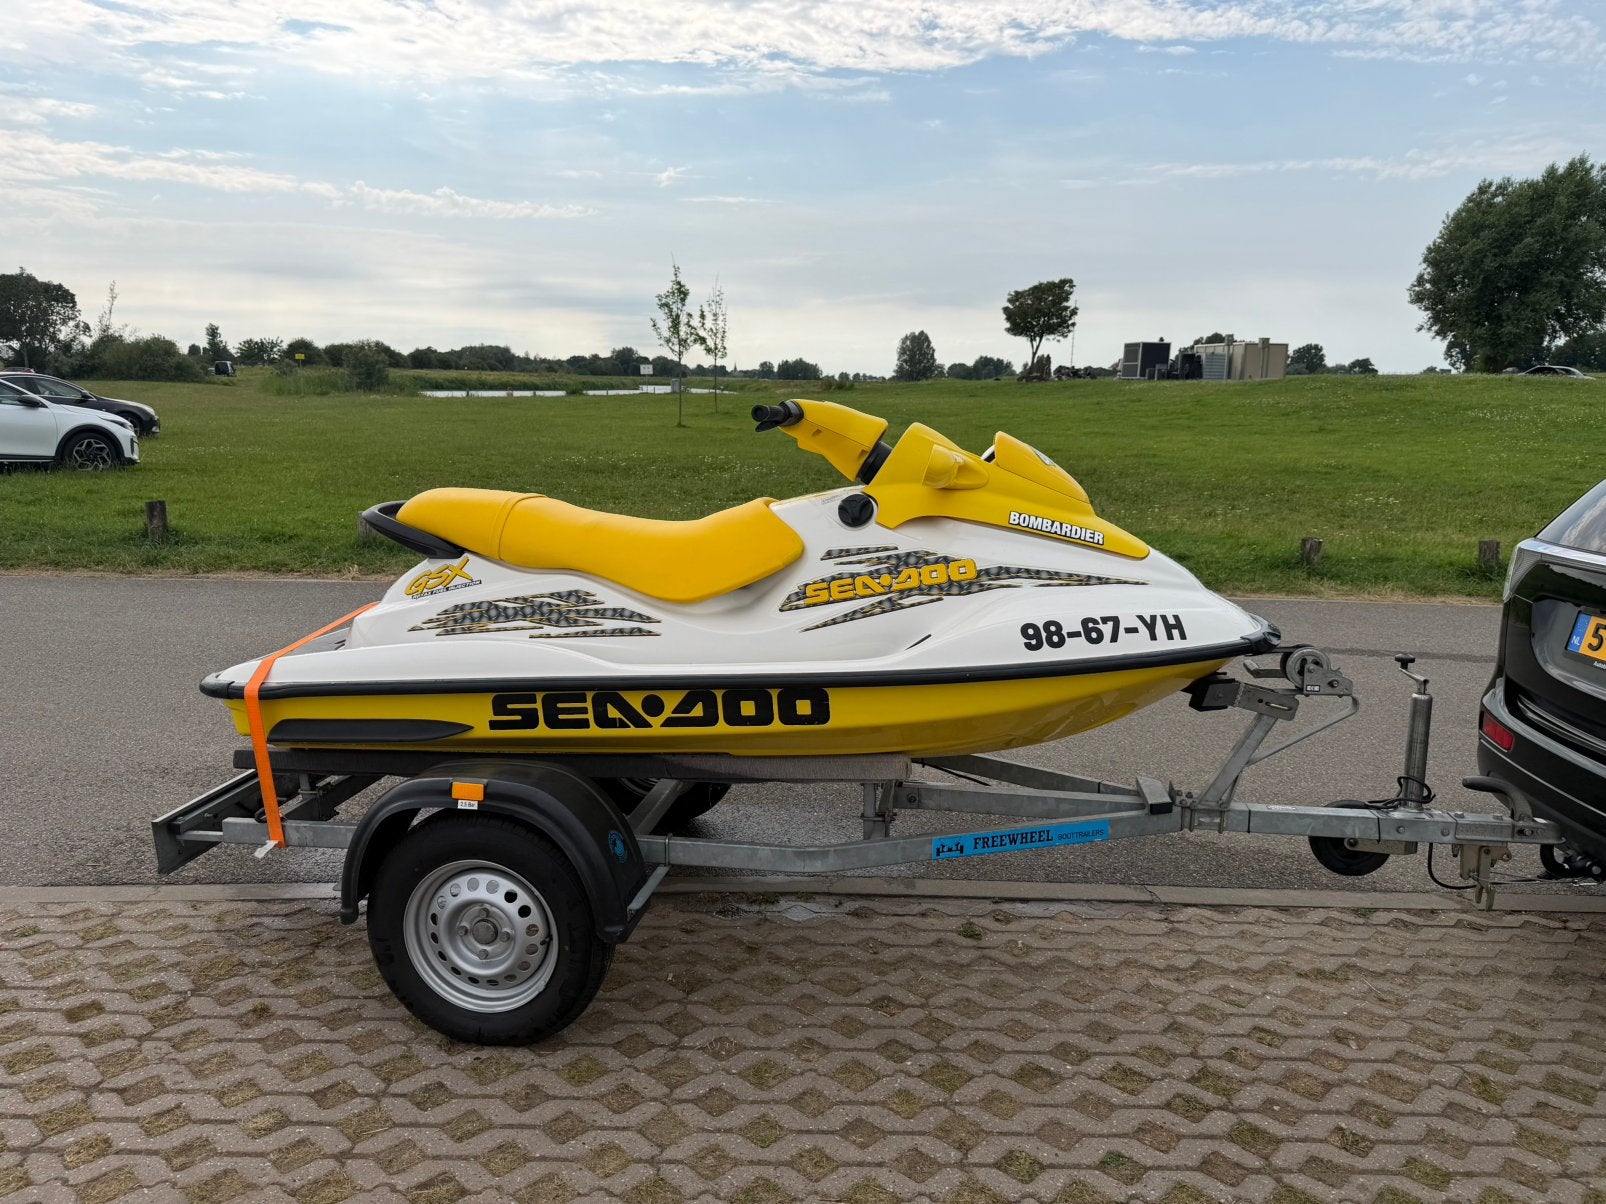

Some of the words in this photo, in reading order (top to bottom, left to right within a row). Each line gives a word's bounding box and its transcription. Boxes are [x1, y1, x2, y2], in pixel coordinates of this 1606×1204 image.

[1009, 511, 1105, 546] BOMBARDIER
[405, 555, 474, 596] GSX
[1020, 614, 1188, 652] 98-67-YH
[1571, 635, 1581, 646] NL
[973, 829, 1054, 850] FREEWHEEL
